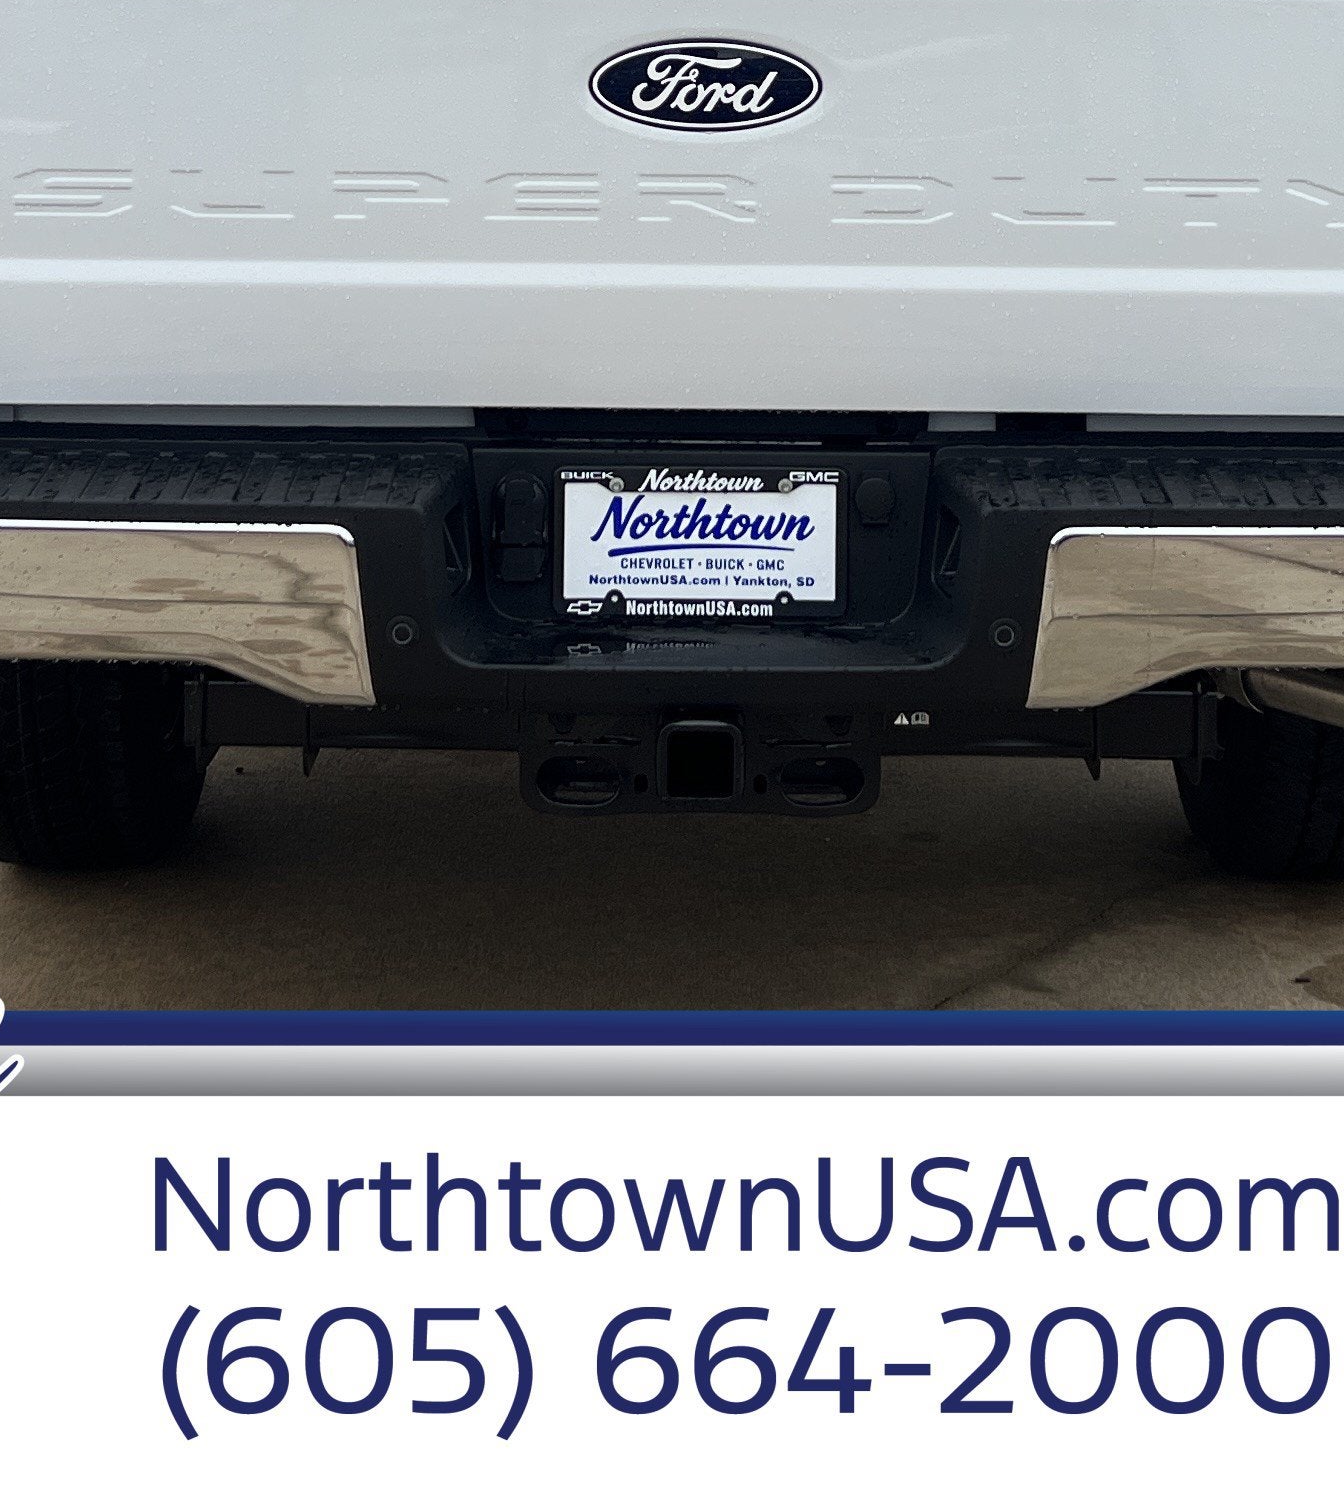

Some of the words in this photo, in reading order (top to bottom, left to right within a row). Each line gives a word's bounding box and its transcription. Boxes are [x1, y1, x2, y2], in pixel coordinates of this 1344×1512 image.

[631, 53, 779, 112] Ford
[13, 168, 757, 222] SUPER
[560, 471, 613, 480] BUICK
[638, 468, 764, 492] Northtown
[789, 471, 840, 483] GMC
[590, 494, 816, 541] Northtown
[620, 558, 695, 570] CHEVROLET
[705, 559, 745, 571] BUICK
[756, 559, 785, 571] GMC
[588, 574, 721, 586] NorthtownUSA.com
[733, 575, 792, 588] Yankton,
[796, 575, 815, 587] SD
[626, 600, 773, 617] NorthtownUSA.com
